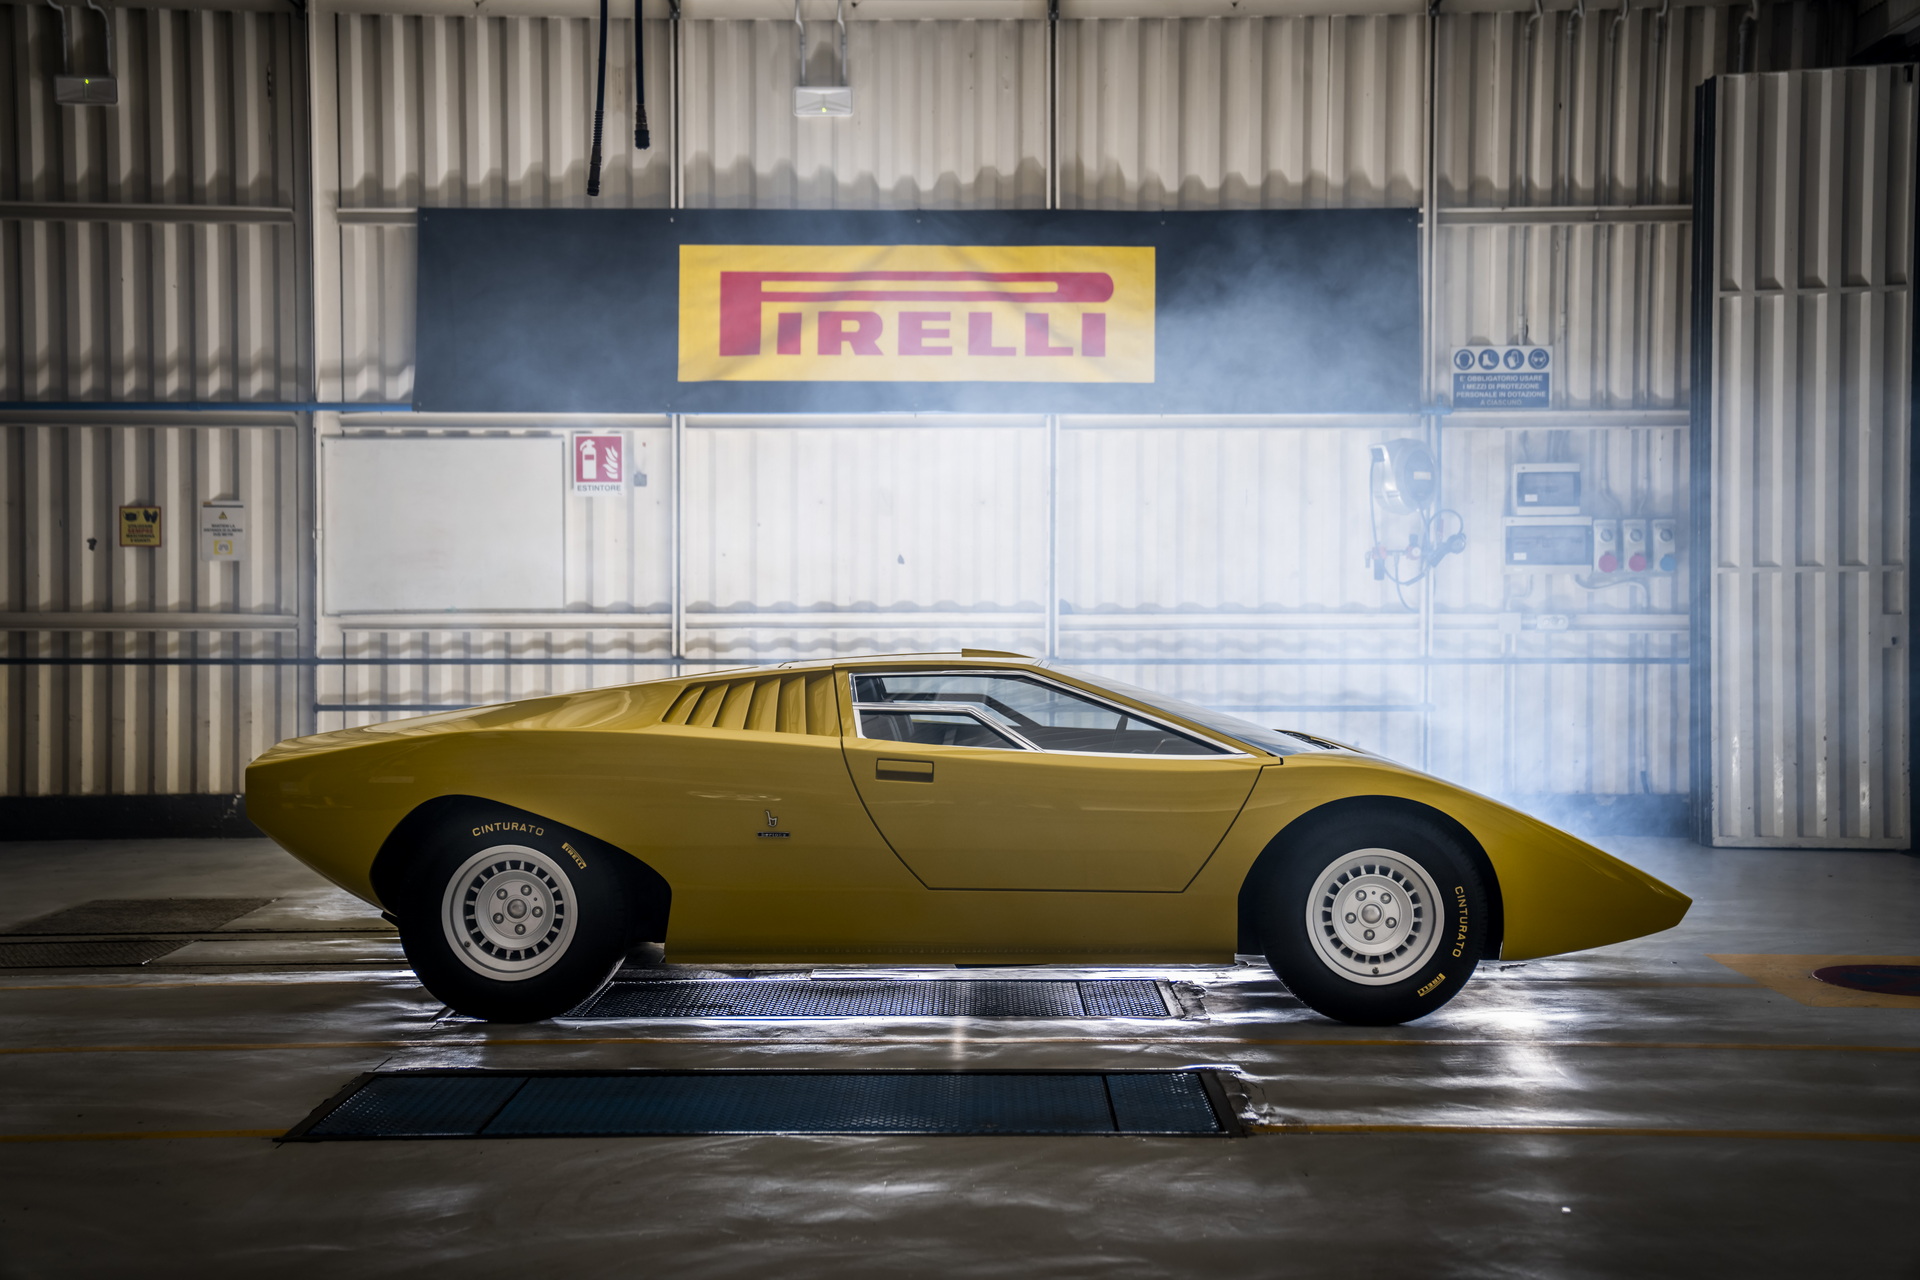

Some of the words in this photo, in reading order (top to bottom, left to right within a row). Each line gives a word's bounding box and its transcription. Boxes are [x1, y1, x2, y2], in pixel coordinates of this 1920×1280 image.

[719, 271, 1114, 357] PIRELLI
[577, 484, 621, 492] ESTINTORE
[472, 822, 545, 837] CINTURATO
[562, 842, 587, 870] PIRELLI
[1452, 886, 1469, 958] CINTURATO
[1417, 972, 1446, 997] PIRELLI
